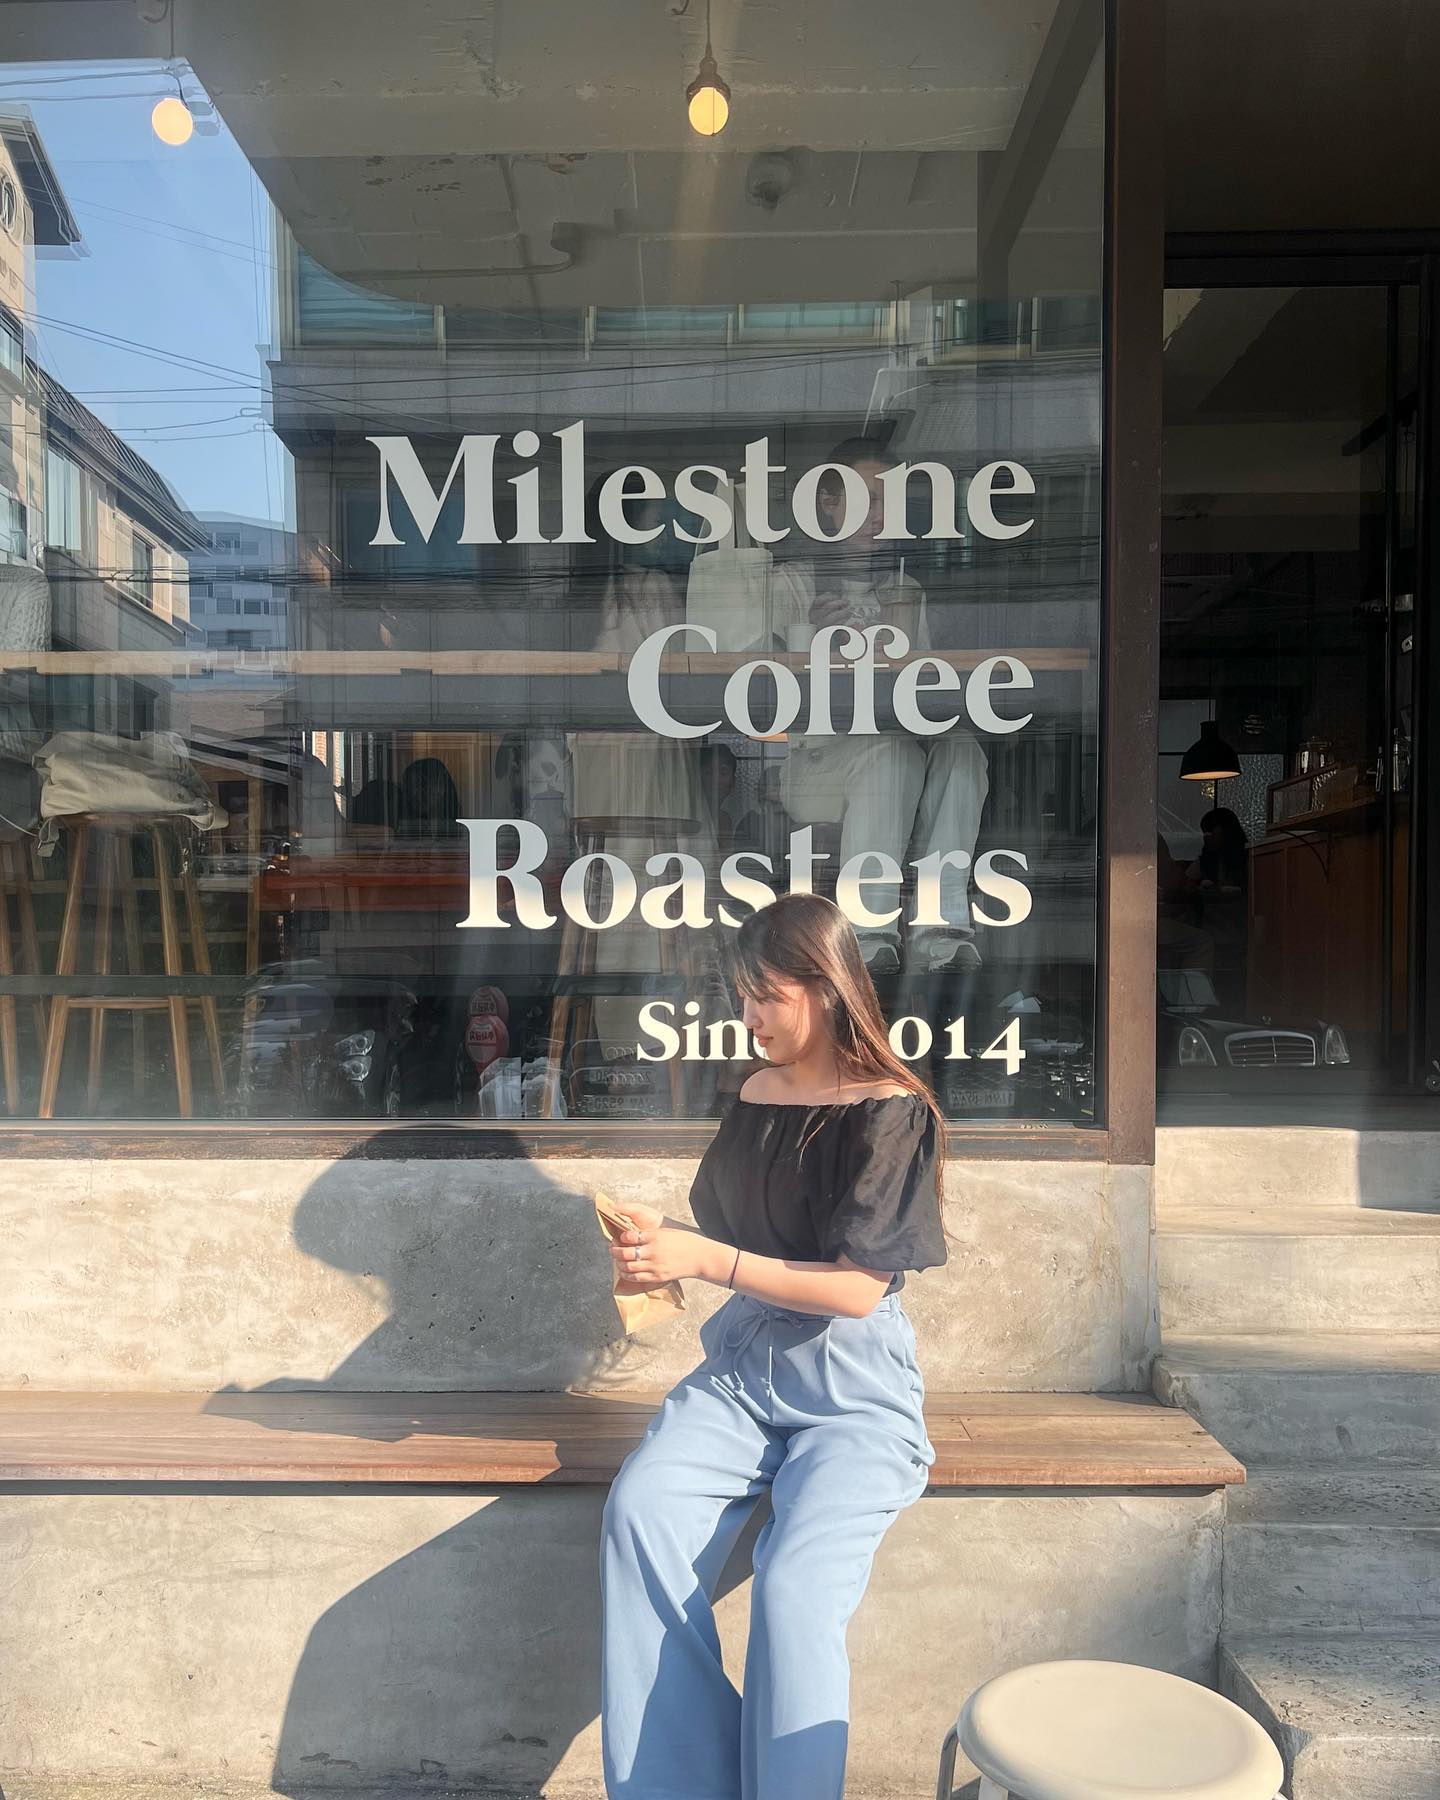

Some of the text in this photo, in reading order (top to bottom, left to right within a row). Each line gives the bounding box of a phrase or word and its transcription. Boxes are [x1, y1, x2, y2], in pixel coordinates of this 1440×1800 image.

[366, 420, 1036, 545] Milestone
[627, 624, 1034, 739] Coffee
[455, 818, 1034, 930] Roasters
[636, 1000, 1027, 1076] Sin 014
